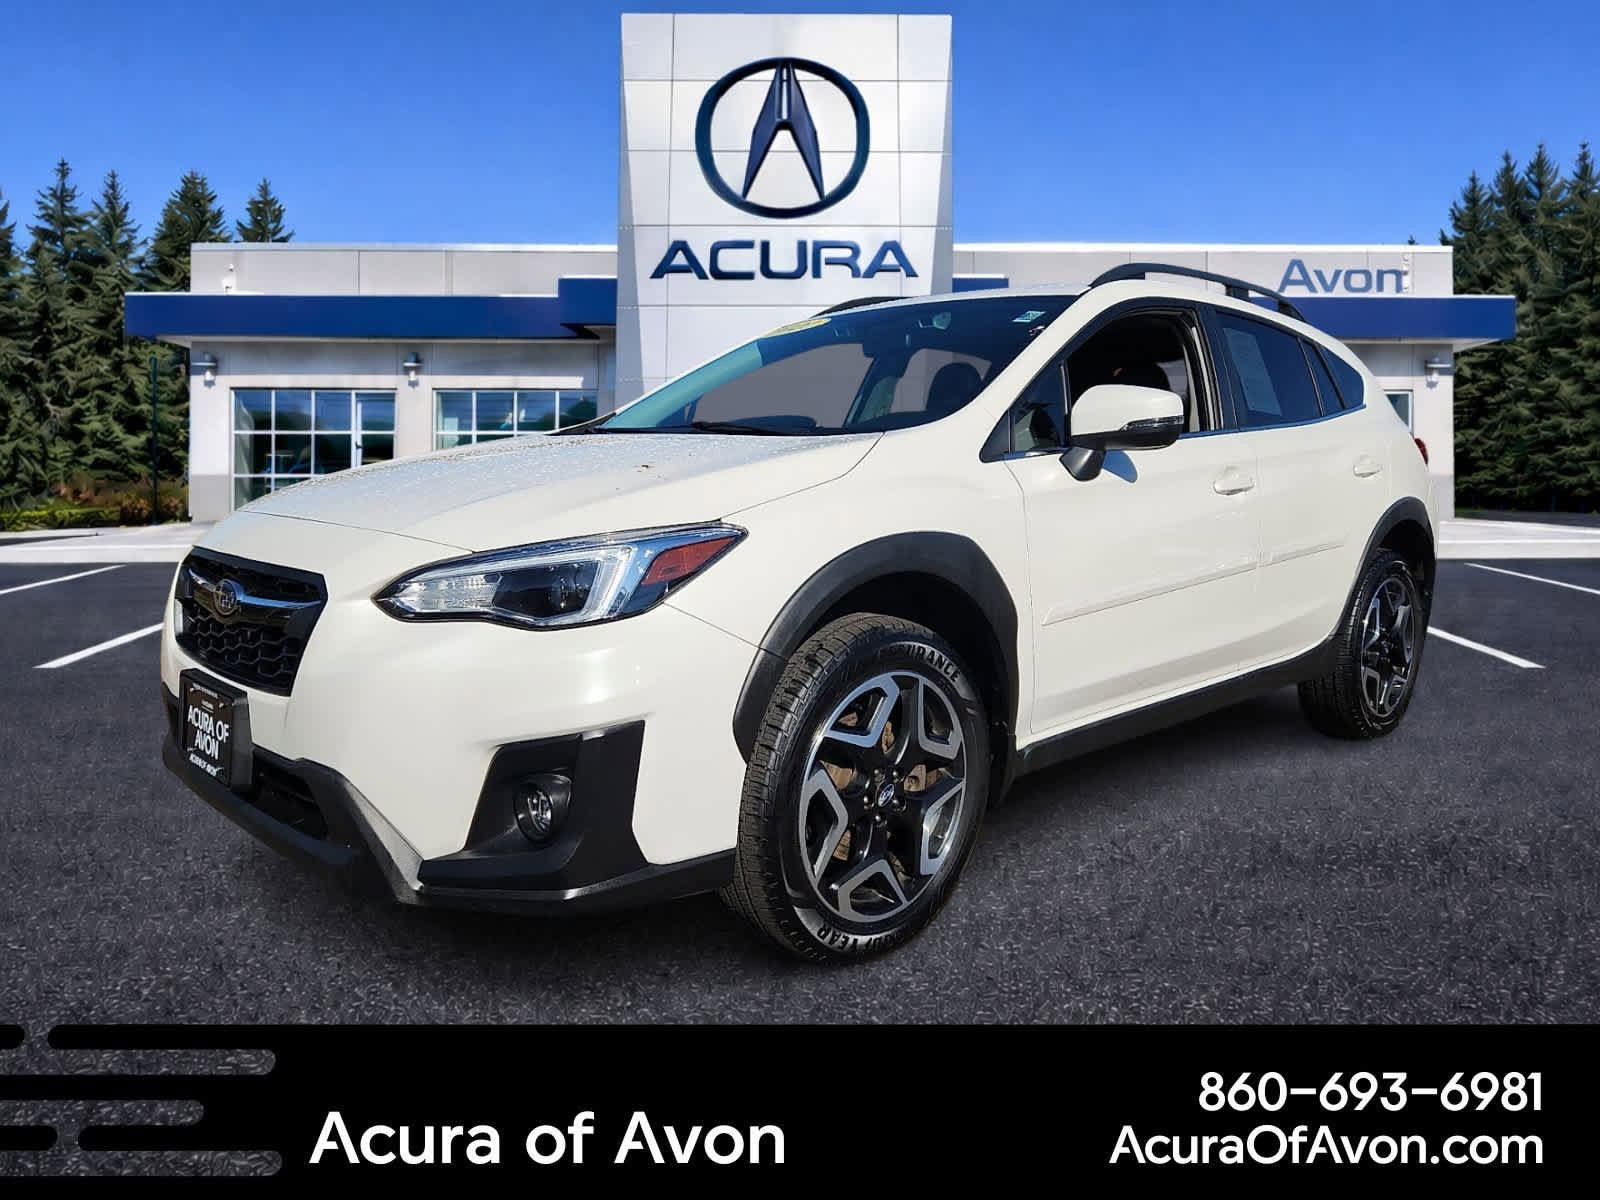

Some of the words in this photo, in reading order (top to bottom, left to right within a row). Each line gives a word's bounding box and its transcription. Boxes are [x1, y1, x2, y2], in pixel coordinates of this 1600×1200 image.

[649, 239, 919, 281] ACURA
[1278, 258, 1403, 293] Avon
[187, 704, 215, 737] ACURA
[216, 720, 230, 743] OF
[194, 729, 219, 760] AVON
